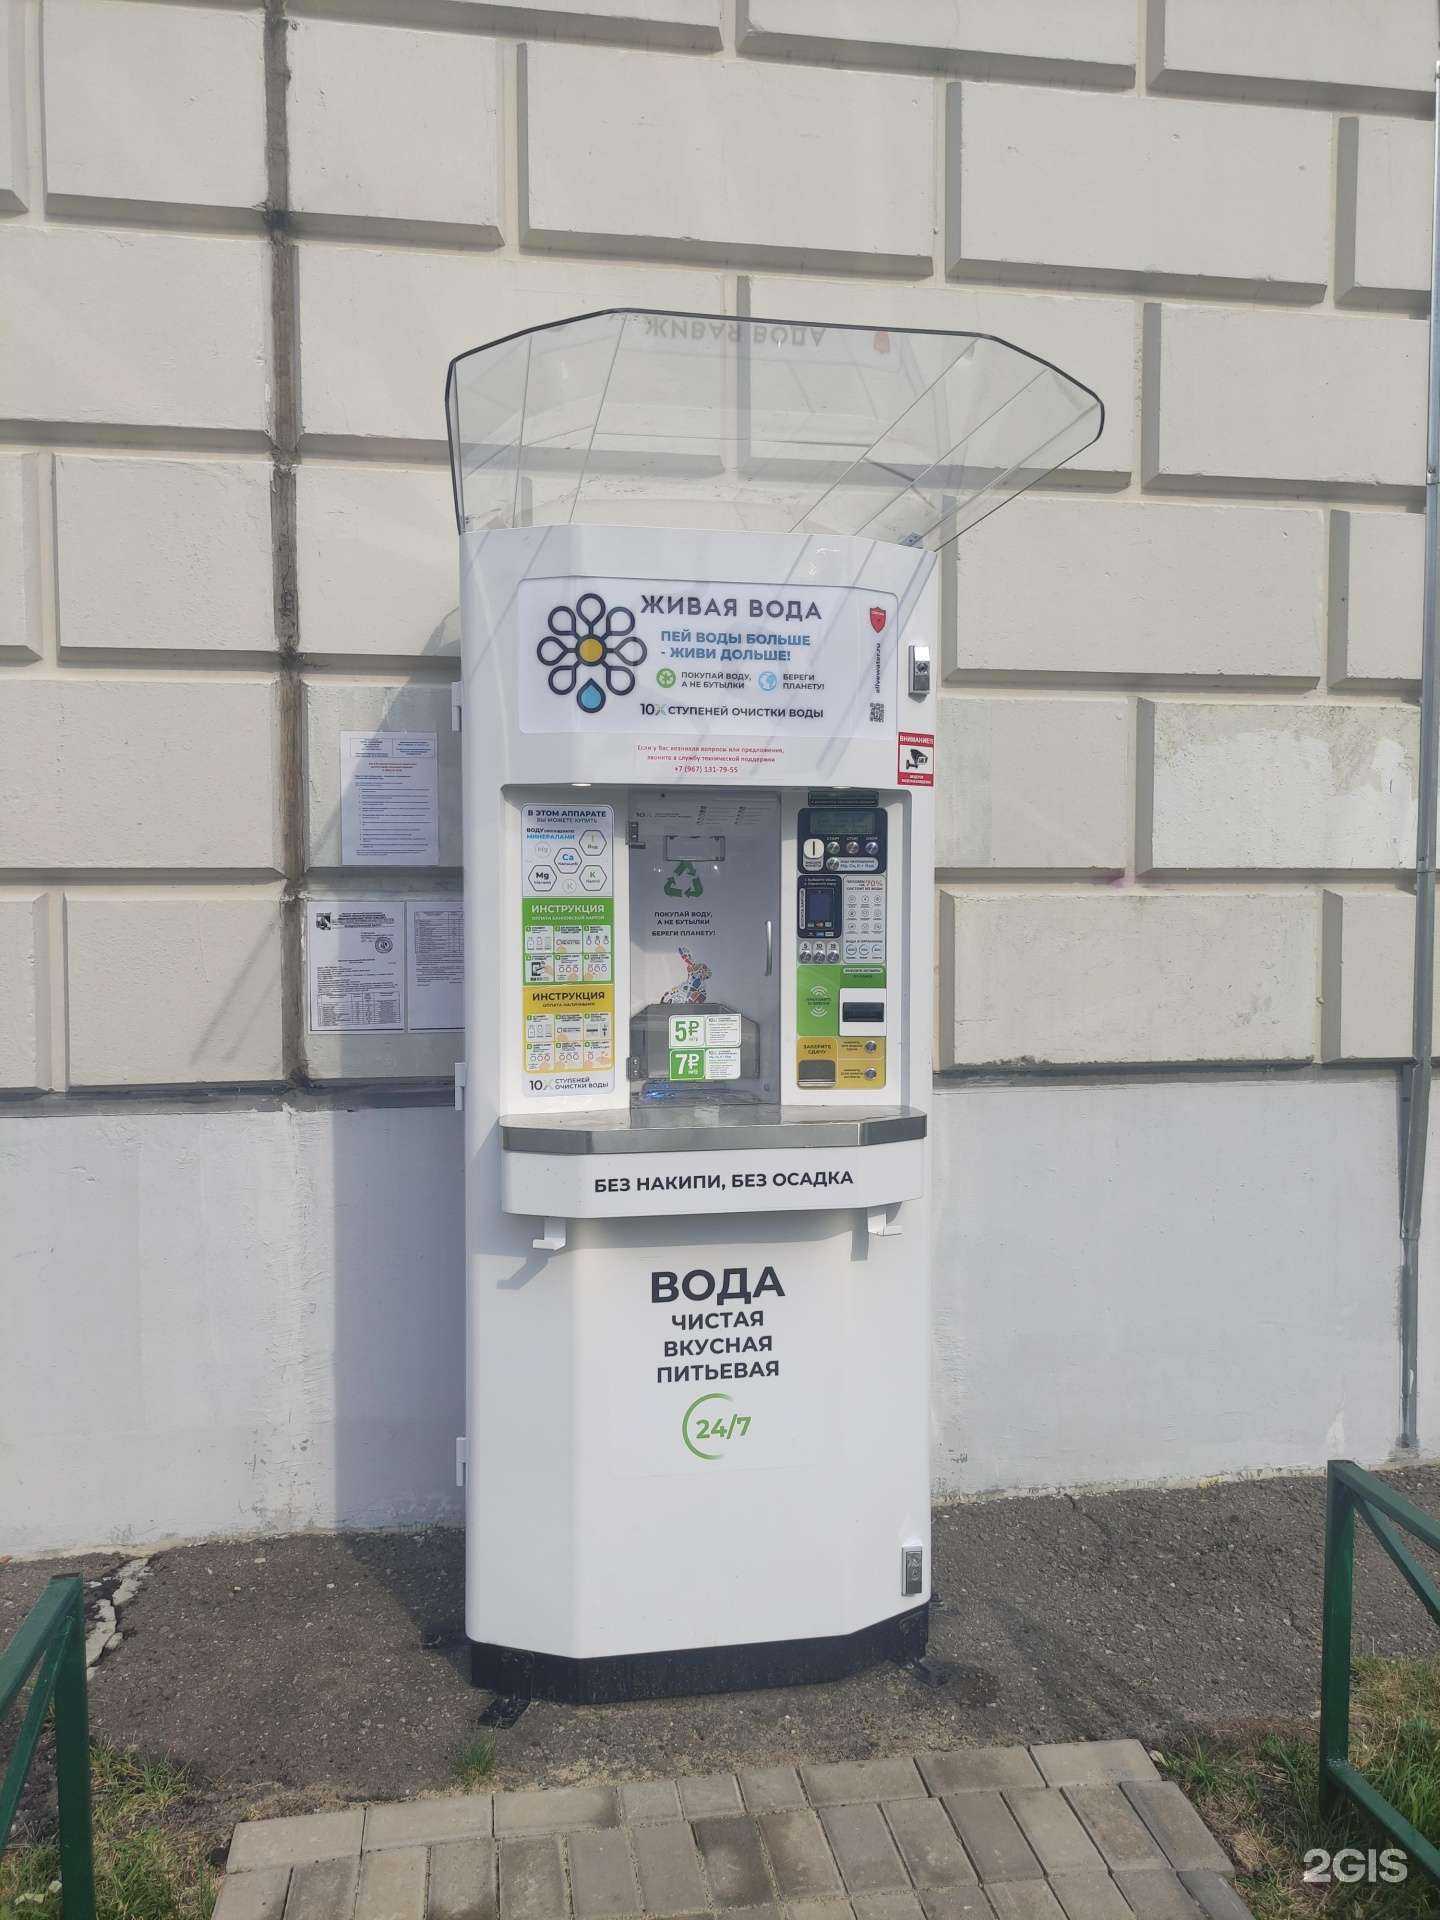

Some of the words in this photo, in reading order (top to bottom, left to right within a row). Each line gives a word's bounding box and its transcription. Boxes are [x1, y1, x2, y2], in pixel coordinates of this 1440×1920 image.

[640, 594, 738, 617] ЖИВАЯ
[749, 599, 822, 622] ВОДА
[661, 629, 691, 643] ПЕЙ
[696, 632, 742, 646] ВОДЫ
[746, 633, 811, 646] БОЛЬШЕ
[670, 647, 717, 659] ЖИВИ
[720, 649, 791, 662] ДОЛЬШЕ!
[681, 671, 724, 680] ПОКУПАЙ
[725, 673, 752, 681] ВОДУ,
[783, 673, 815, 681] БЕРЕГИ
[783, 682, 824, 690] ПЛАНЕТУ!
[668, 704, 728, 716] СТУПЕНЕЙ
[731, 707, 785, 717] ОЧИСТКИ
[789, 708, 824, 719] ВОДЫ
[536, 809, 560, 817] ЭТОМ
[562, 853, 574, 861] Ca
[535, 872, 550, 880] Mg
[531, 904, 605, 914] ИНСТРУКЦИЯ
[532, 991, 605, 1001] ИНСТРУКЦИЯ
[594, 1178, 631, 1193] БЕЗ
[636, 1174, 727, 1192] НАКИПИ,
[731, 1173, 768, 1188] БЕЗ
[772, 1171, 854, 1187] ОСАДКА
[651, 1266, 786, 1305] ВОДА
[672, 1310, 764, 1331] ЧИСТАЯ
[664, 1335, 773, 1357] ВКУСНАЯ
[657, 1360, 780, 1384] ПИТЬЕВАЯ
[696, 1414, 752, 1440] 24/7
